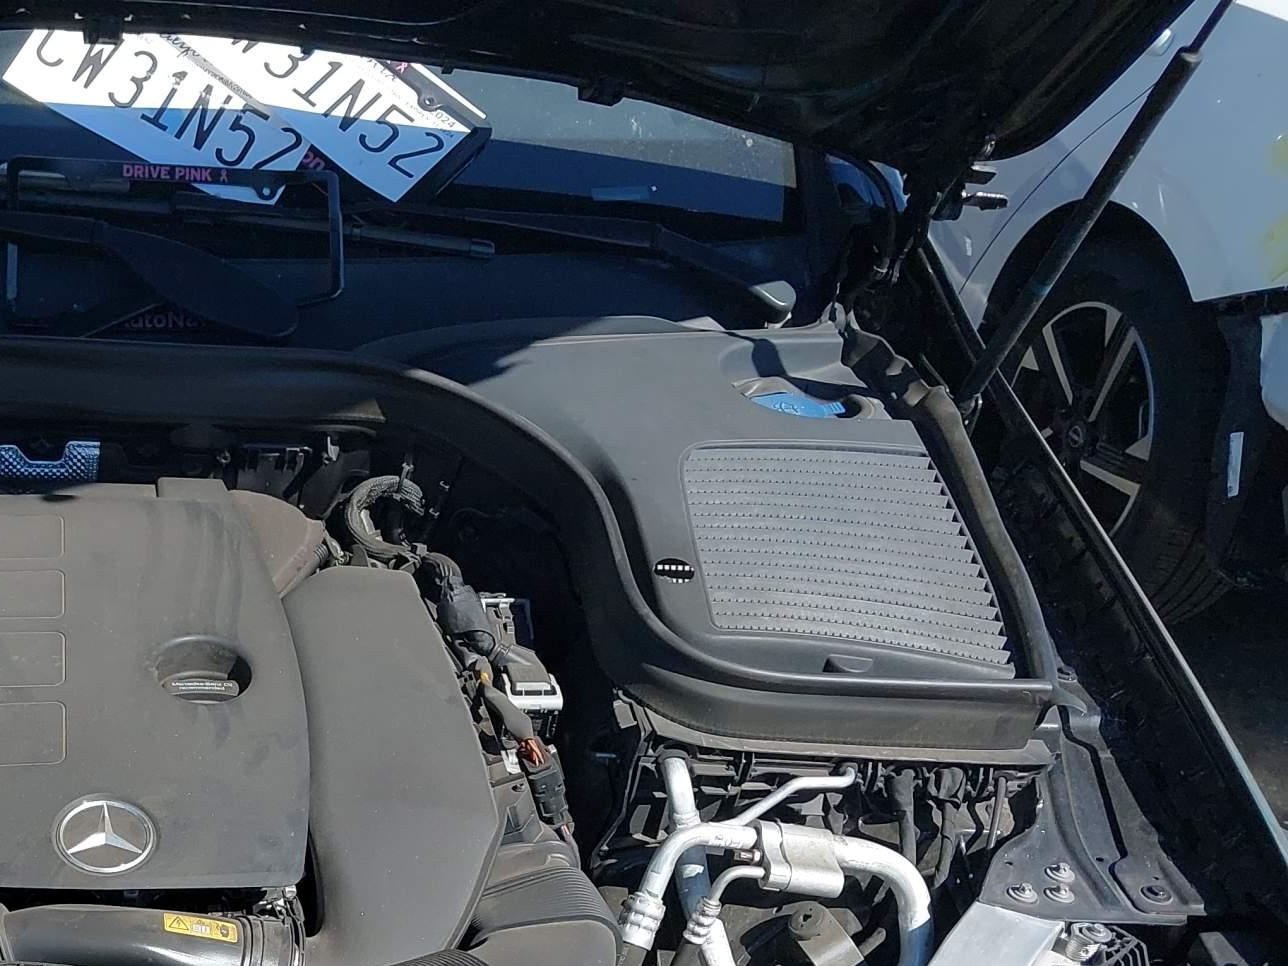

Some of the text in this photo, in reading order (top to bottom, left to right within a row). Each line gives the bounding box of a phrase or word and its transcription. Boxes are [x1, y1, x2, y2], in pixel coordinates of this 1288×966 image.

[35, 29, 302, 170] CW31N52
[123, 164, 212, 182] DRIVE PINK
[125, 311, 204, 329] utoNa
